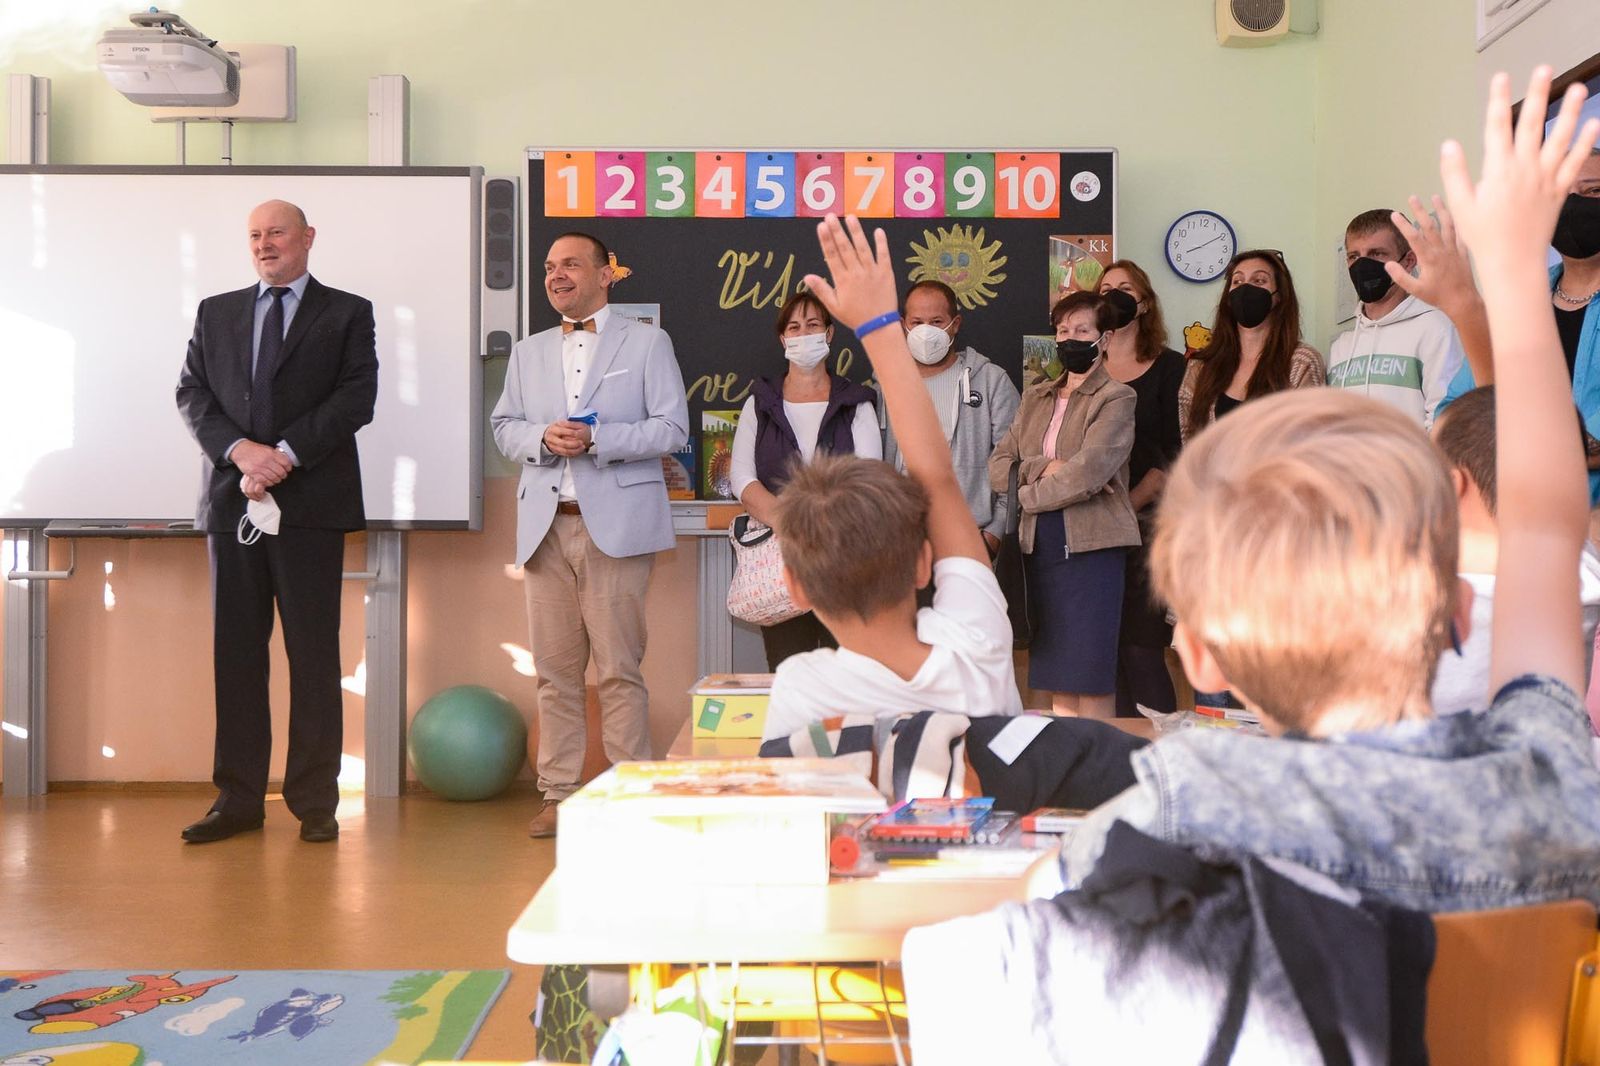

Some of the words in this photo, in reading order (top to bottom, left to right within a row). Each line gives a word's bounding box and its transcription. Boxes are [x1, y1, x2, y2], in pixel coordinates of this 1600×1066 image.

[557, 165, 578, 209] 1
[604, 165, 636, 210] 2
[655, 165, 686, 210] 3
[702, 166, 737, 210] 4
[754, 166, 786, 210] 5
[802, 166, 836, 211] 6
[853, 167, 885, 210] 7
[902, 166, 936, 211] 8
[953, 166, 986, 210] 9
[998, 166, 1056, 211] 10
[1187, 221, 1196, 230] 11
[1199, 219, 1209, 228] 12
[1213, 222, 1217, 231] 1
[1178, 229, 1187, 238] 10
[1220, 232, 1227, 241] 2
[1173, 241, 1179, 249] 9
[1222, 245, 1228, 254] 3
[1176, 253, 1182, 262] 8
[1184, 262, 1190, 271] 7
[1208, 265, 1214, 274] 5
[1196, 267, 1202, 276] 6
